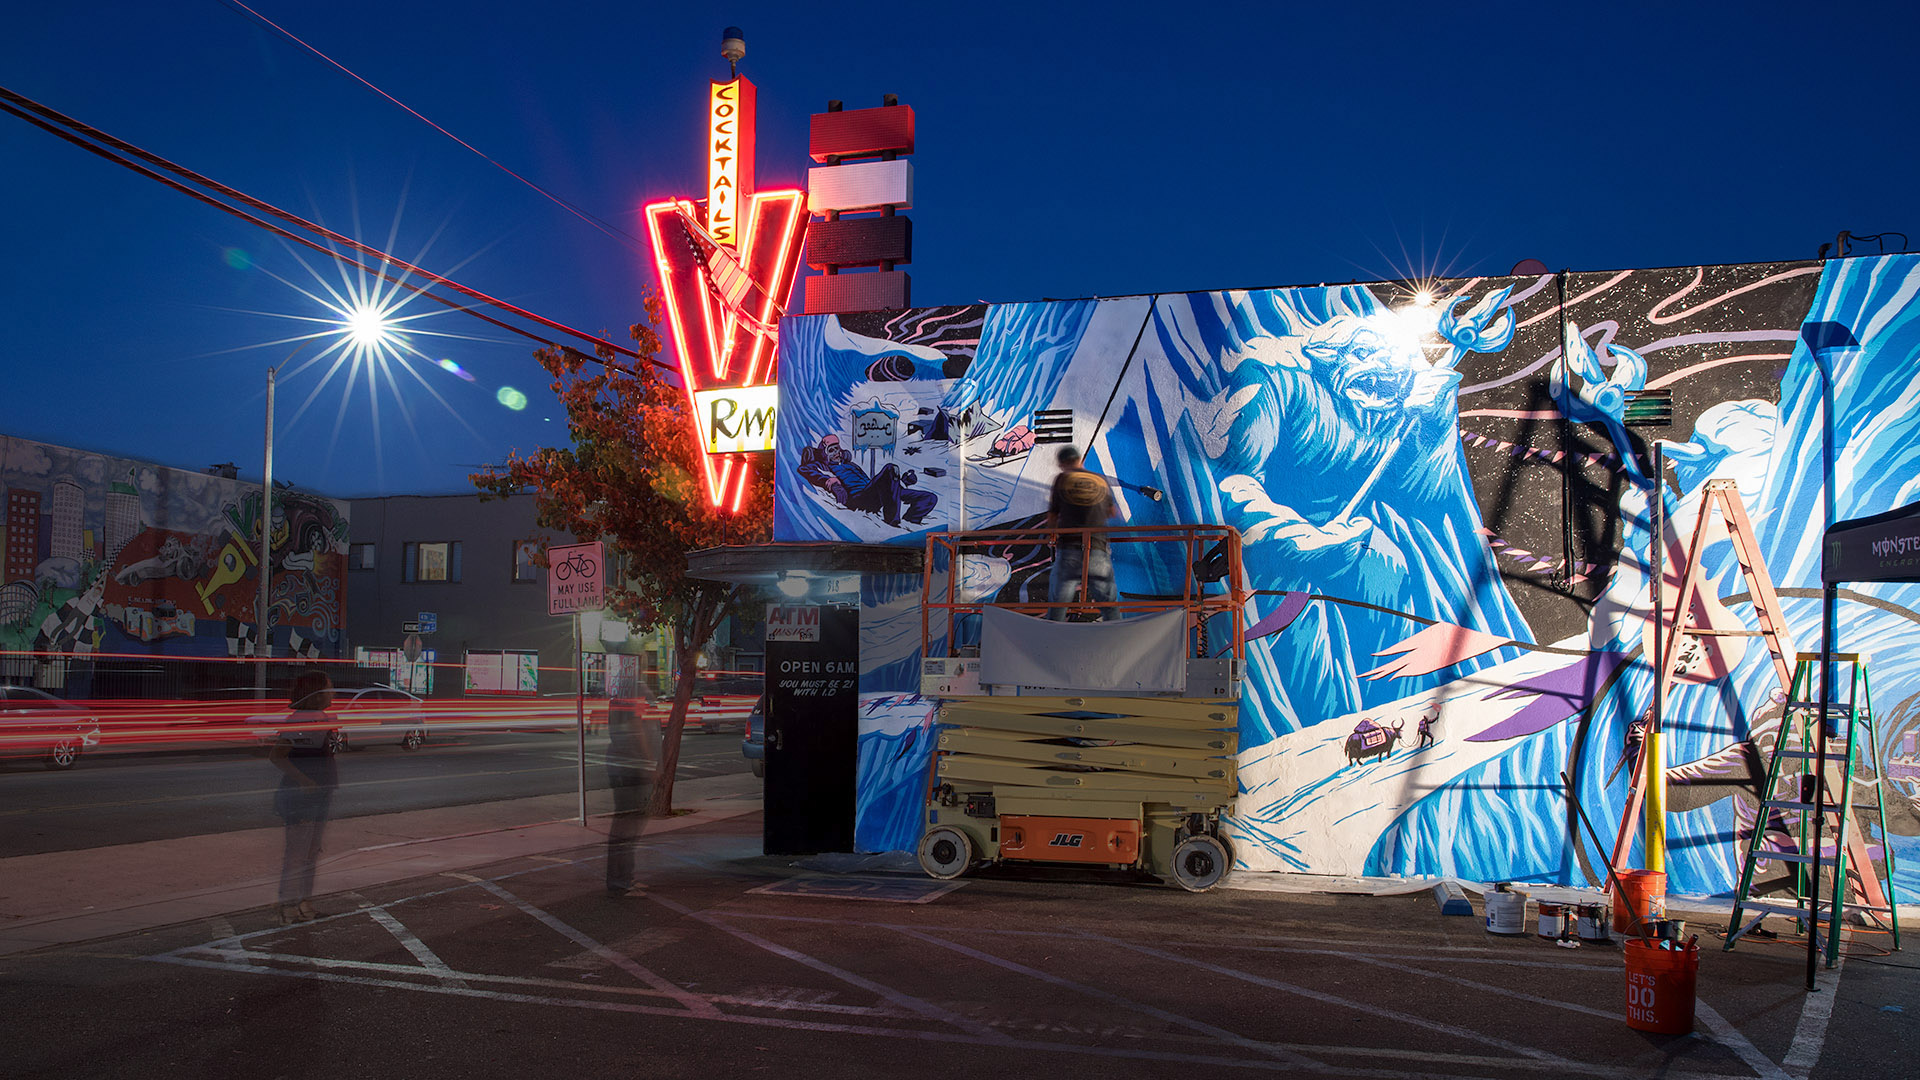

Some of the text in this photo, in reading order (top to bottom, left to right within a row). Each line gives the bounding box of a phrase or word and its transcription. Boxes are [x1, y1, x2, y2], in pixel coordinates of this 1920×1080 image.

[714, 86, 734, 242] COCKTAILS
[558, 582, 595, 595] MAY USE
[553, 595, 601, 609] FULL LANE
[768, 607, 819, 625] ATM
[780, 660, 820, 673] OPEN
[779, 679, 855, 689] YOU MUST BE 21
[793, 688, 817, 697] WITH
[1049, 833, 1084, 848] JLG
[1628, 971, 1656, 987] LET'S
[1628, 983, 1656, 1008] DO
[1628, 1005, 1659, 1024] THIS.
